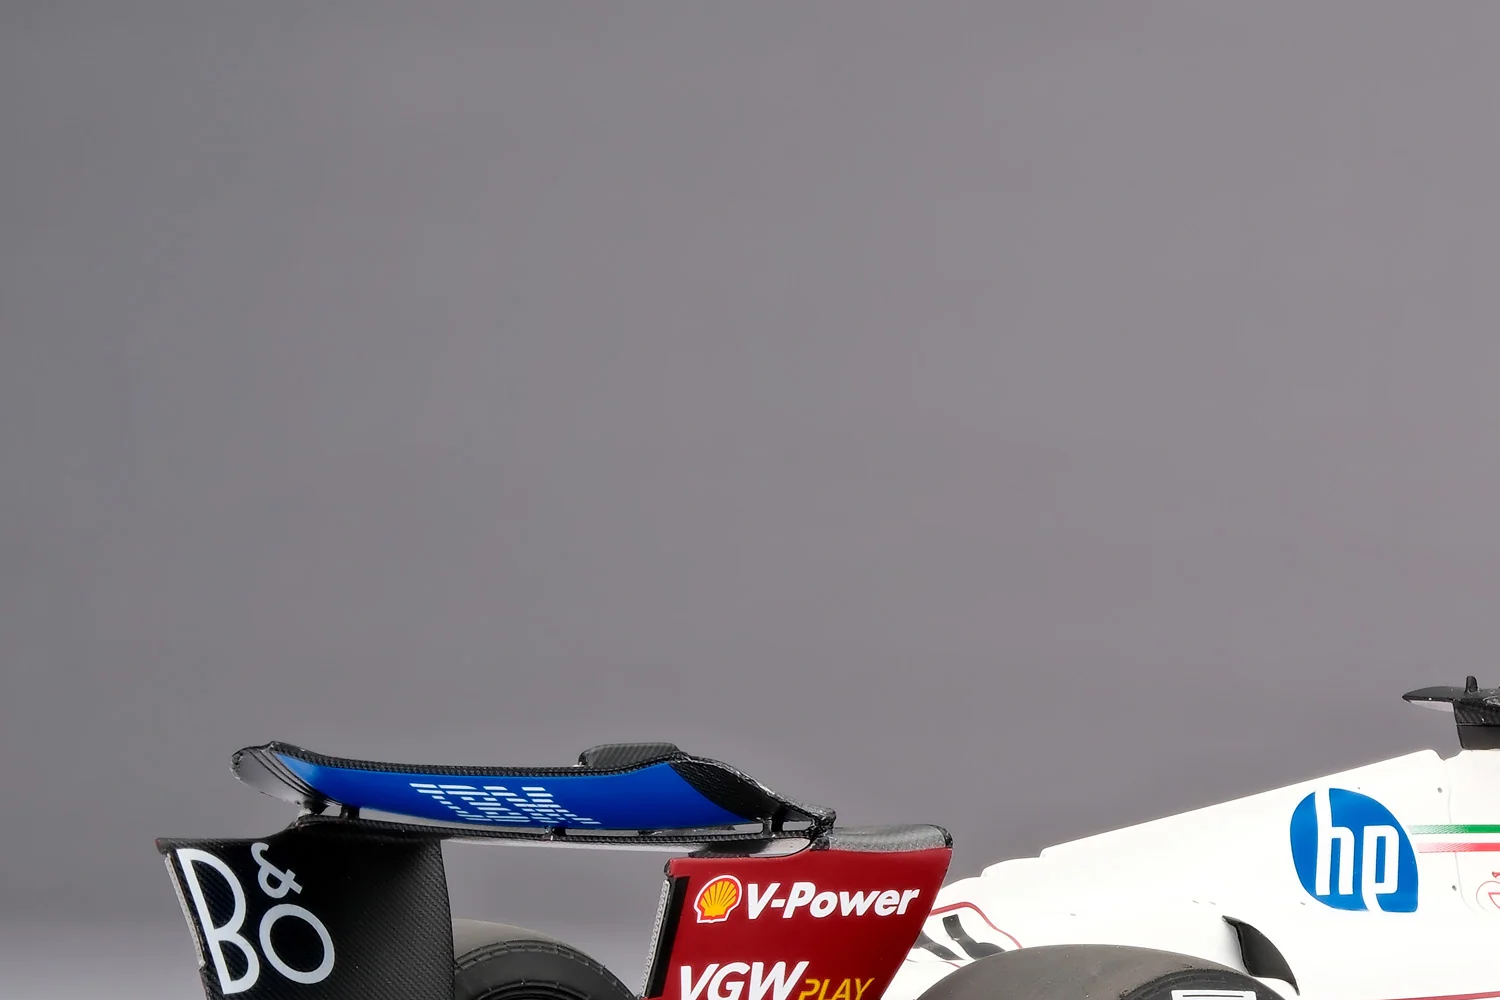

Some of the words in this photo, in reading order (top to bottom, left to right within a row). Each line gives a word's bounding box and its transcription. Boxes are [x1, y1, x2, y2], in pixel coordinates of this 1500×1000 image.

[409, 782, 602, 825] IBM
[1314, 786, 1400, 912] hp
[747, 881, 920, 919] V-Power
